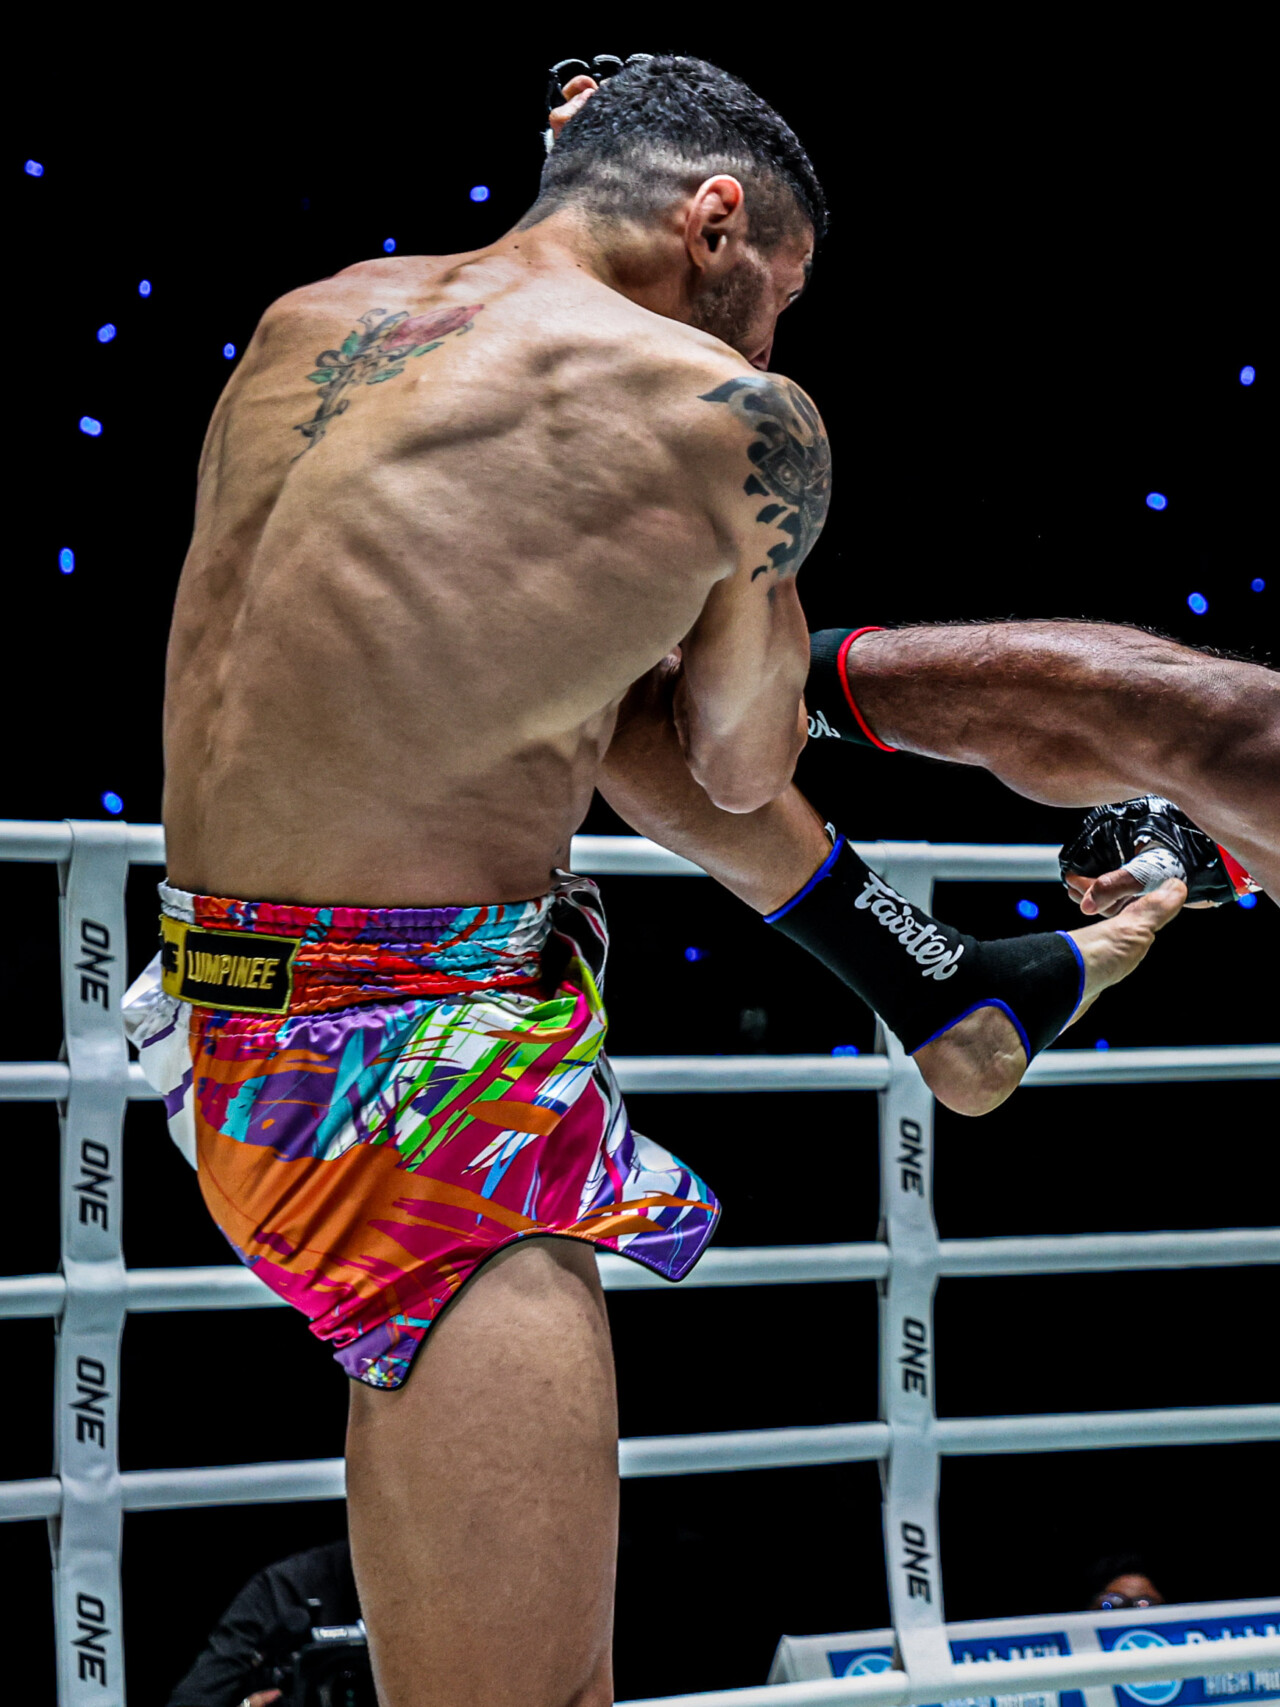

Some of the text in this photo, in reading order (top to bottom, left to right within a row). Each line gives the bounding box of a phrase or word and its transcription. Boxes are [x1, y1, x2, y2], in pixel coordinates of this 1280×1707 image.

[74, 917, 117, 1012] ONE
[186, 950, 281, 990] LUMPINEE
[854, 870, 965, 981] Fairtex
[72, 1137, 115, 1232] ONE
[896, 1115, 926, 1199] ONE
[67, 1354, 113, 1450] ONE
[898, 1315, 931, 1400] ONE
[899, 1519, 934, 1605] ONE
[70, 1590, 113, 1689] ONE
